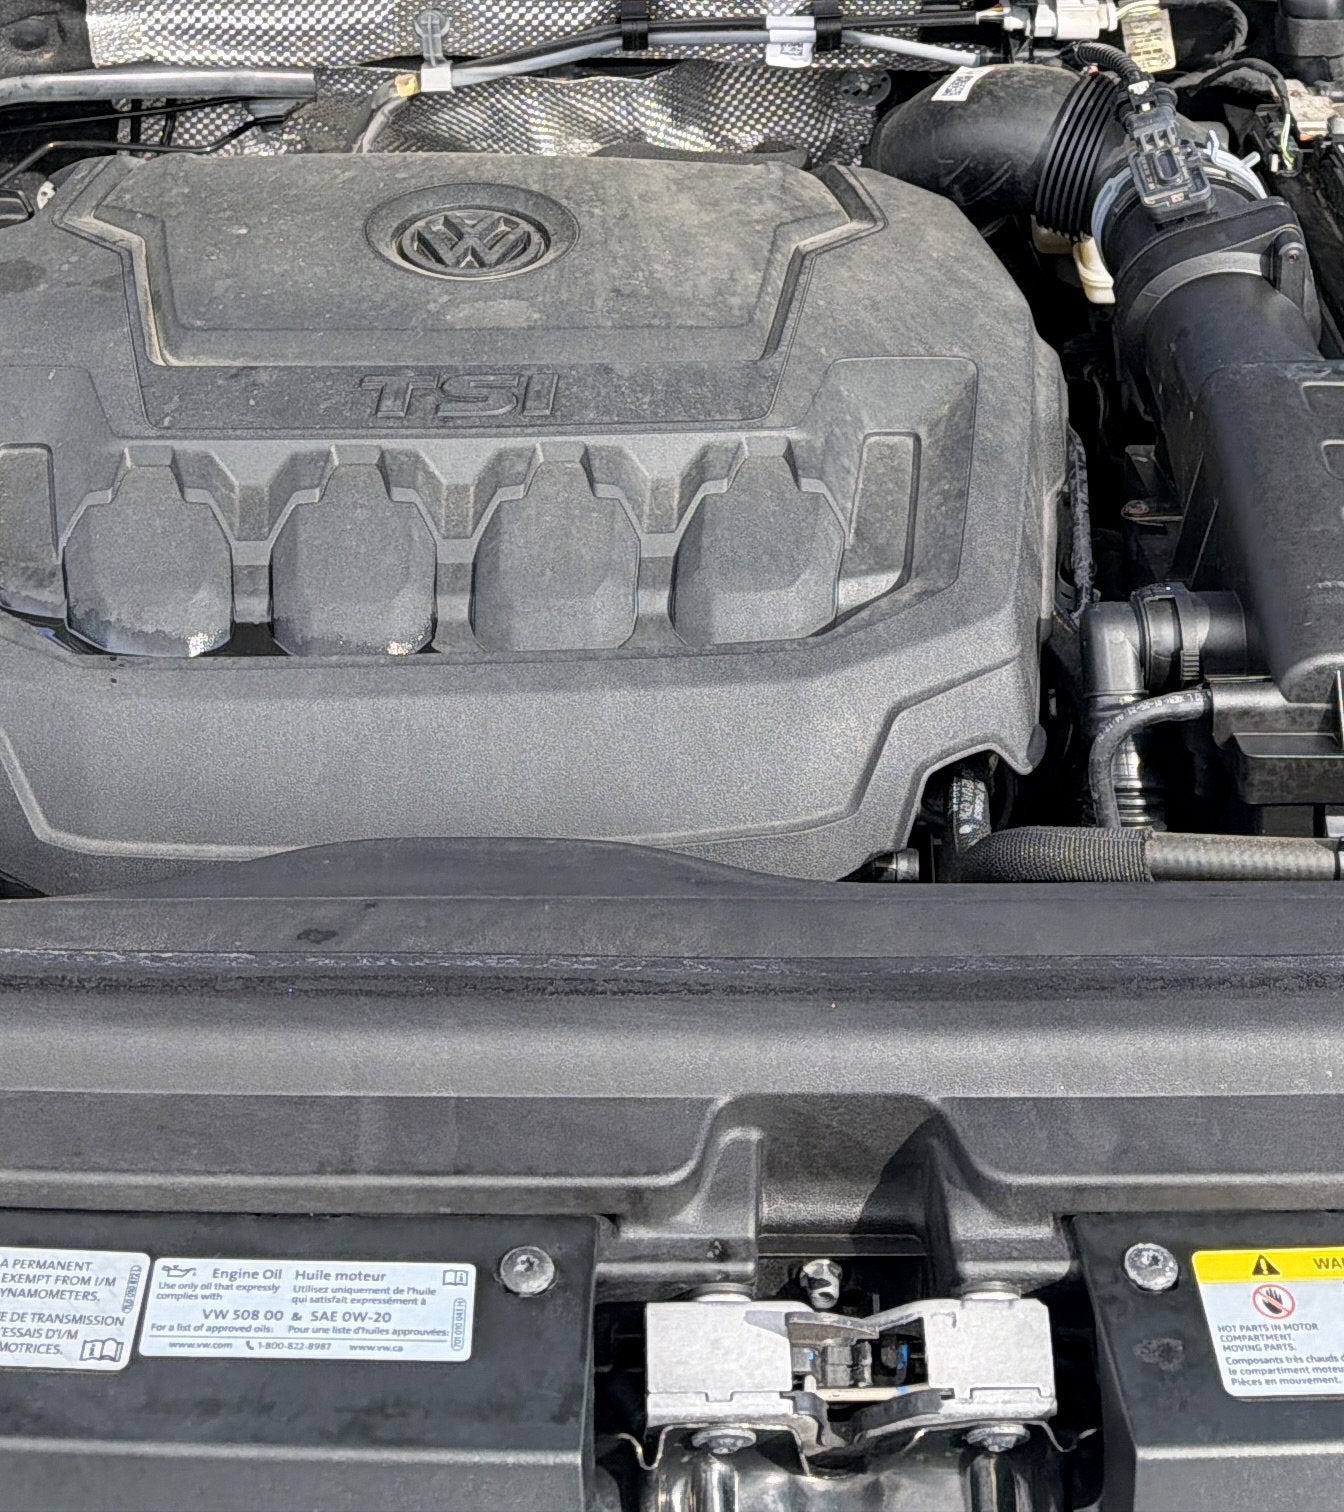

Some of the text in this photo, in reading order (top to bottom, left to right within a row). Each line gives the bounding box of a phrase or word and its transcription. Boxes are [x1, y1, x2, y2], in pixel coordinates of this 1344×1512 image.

[360, 373, 559, 418] TSI
[12, 1259, 93, 1272] PERMANENT
[1, 1274, 52, 1284] EXEMPT
[54, 1275, 92, 1286] FROM
[94, 1277, 116, 1287] I/M
[212, 1268, 282, 1282] Engine Oil
[295, 1270, 386, 1282] Huile moteur
[158, 1282, 280, 1293] Use only that expressly
[293, 1285, 437, 1296] Utilisez uniquement l'huile
[156, 1292, 199, 1302] complies
[291, 1296, 418, 1306] qui satisfait expressément
[9, 1312, 28, 1323] DE
[31, 1313, 125, 1327] TRANSMISSION
[202, 1309, 392, 1323] VW 508 00 SAE 0W-20
[151, 1323, 252, 1334] For list approved
[288, 1326, 309, 1334] Pour
[332, 1326, 351, 1335] liste
[353, 1326, 390, 1336] d'huiles
[1217, 1323, 1318, 1333] HOT PARTS MOTOR
[1220, 1334, 1295, 1343] COMPARTMENT.
[168, 1341, 404, 1352] www.vw.com 1-800-822-8987 www.vw.ca
[1223, 1343, 1297, 1353] MOVING PARTS.
[1226, 1357, 1284, 1367] Composants
[1306, 1354, 1339, 1363] chauds
[1240, 1366, 1310, 1378] compartiment
[1231, 1376, 1343, 1386] Pièces mouvement.
